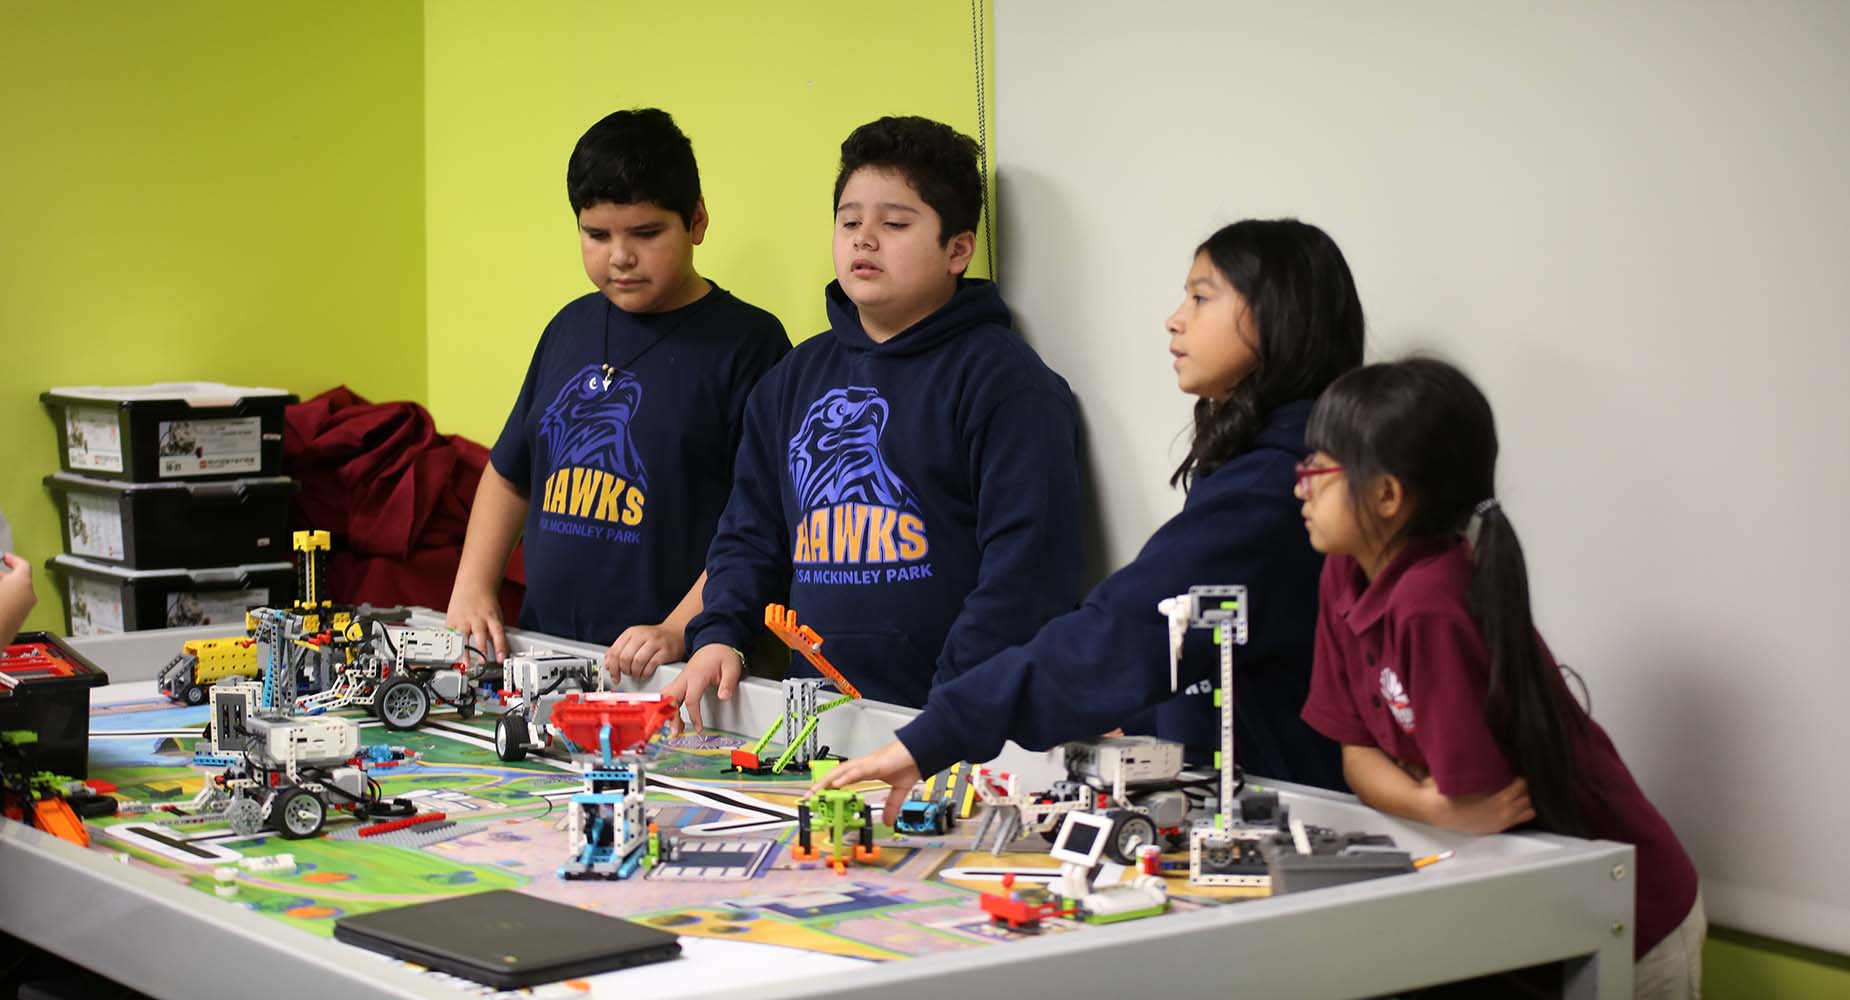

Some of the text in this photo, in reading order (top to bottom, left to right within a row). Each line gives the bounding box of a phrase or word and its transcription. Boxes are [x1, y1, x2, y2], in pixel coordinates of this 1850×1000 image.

[543, 466, 645, 526] HAWKS
[550, 519, 603, 539] MCKINLEY
[606, 528, 641, 544] PARK
[792, 501, 929, 564] HAWKS
[813, 569, 881, 584] MCKINLEY
[886, 563, 934, 583] PARK
